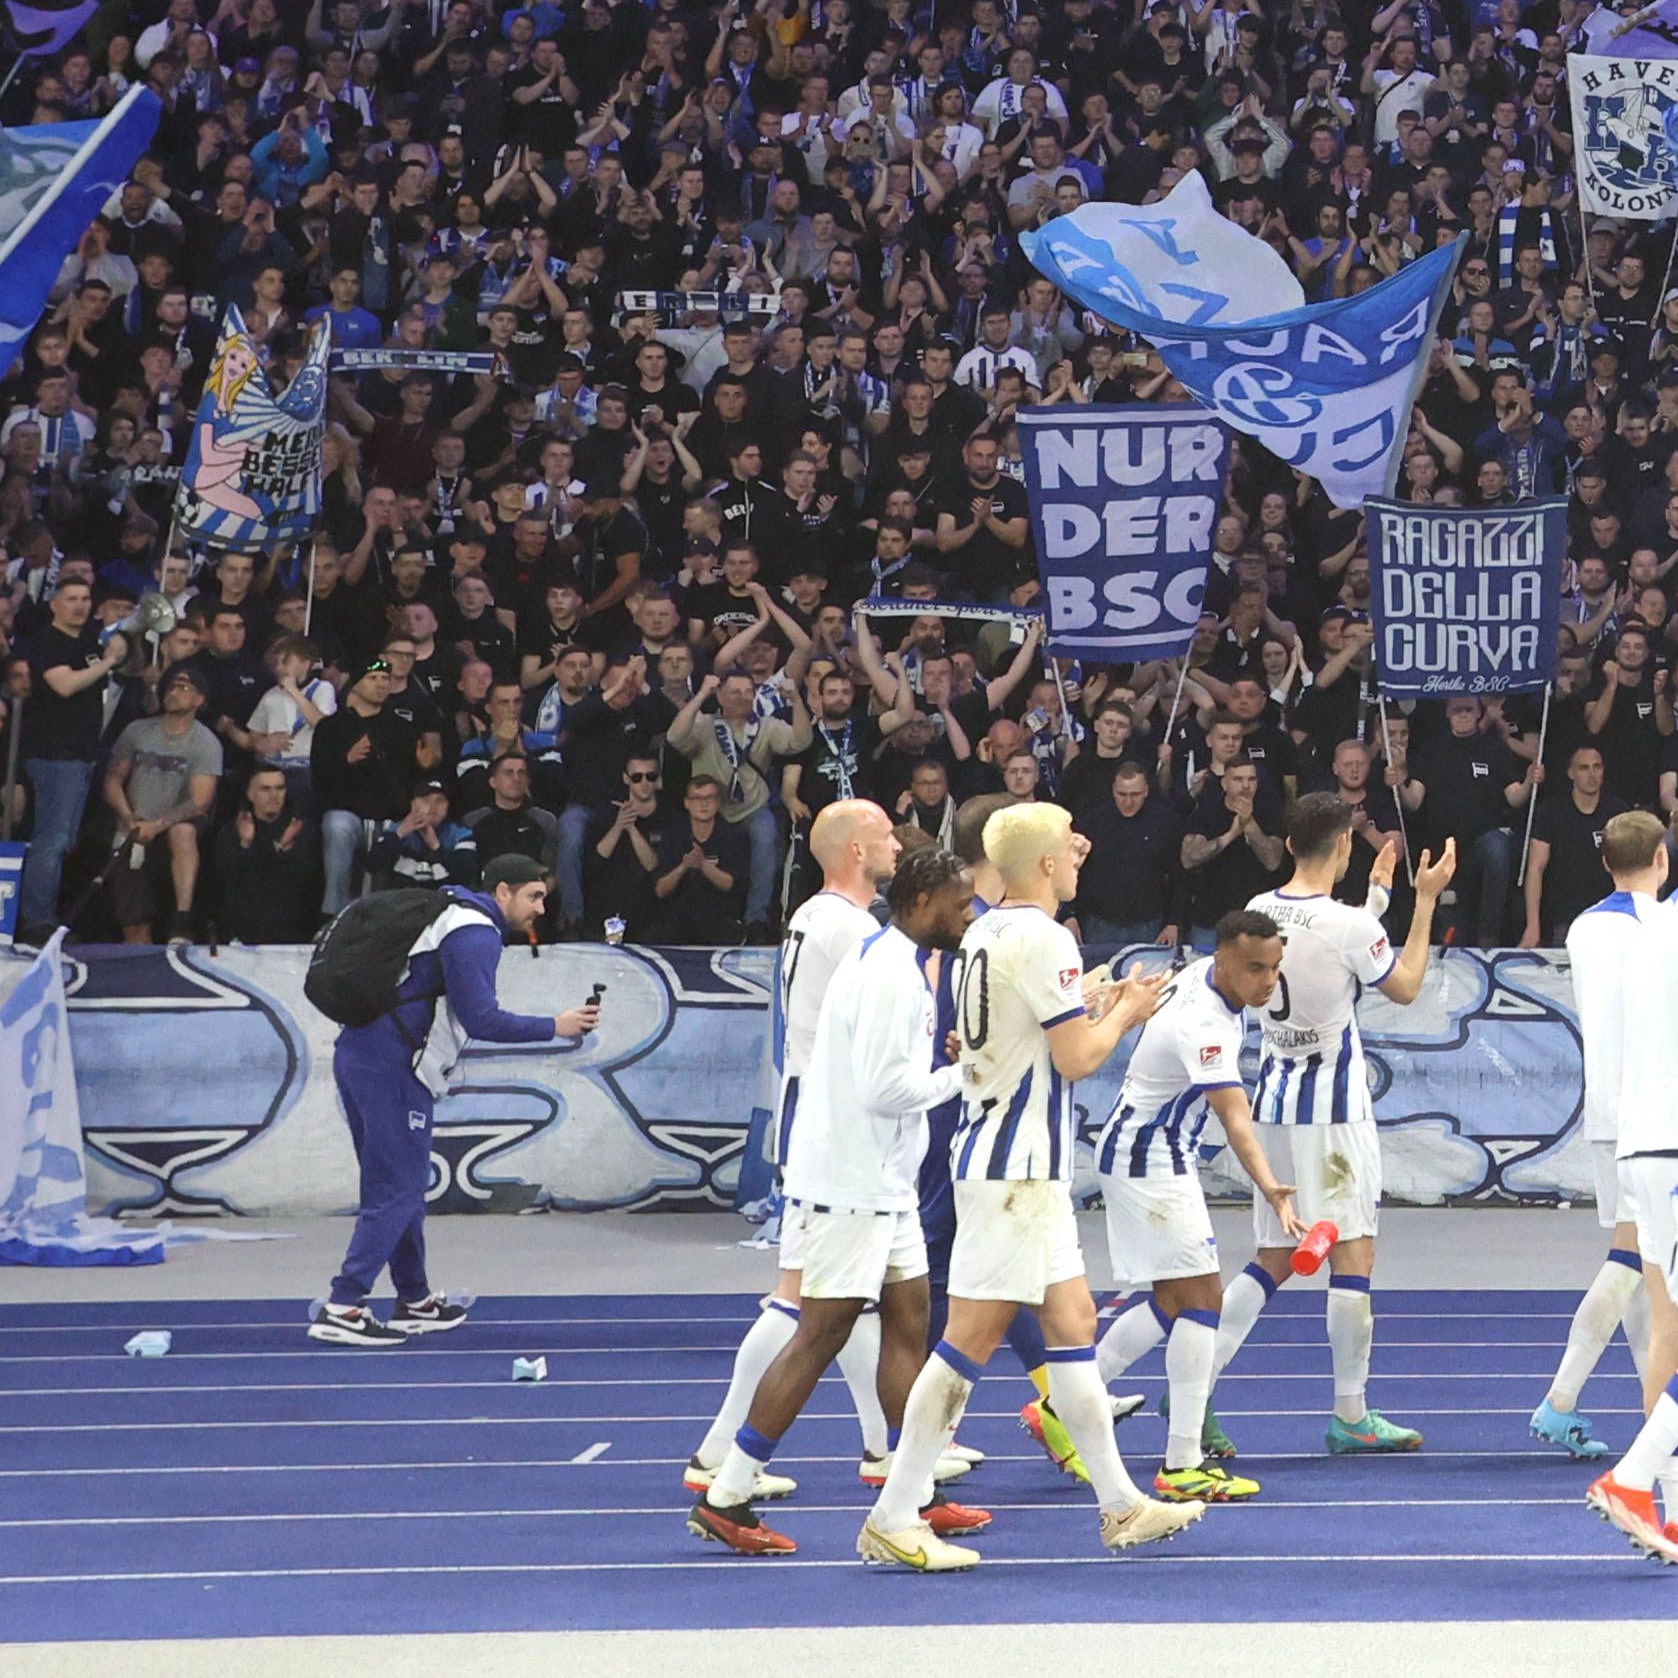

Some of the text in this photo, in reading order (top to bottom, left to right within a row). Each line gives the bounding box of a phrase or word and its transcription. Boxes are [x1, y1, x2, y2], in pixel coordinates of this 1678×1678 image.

[1585, 173, 1678, 212] KOLONN
[1034, 424, 1225, 490] NUR
[1040, 494, 1216, 559] DER
[1379, 512, 1545, 568] RAGAZZI
[1046, 566, 1208, 631] BSC
[1382, 568, 1542, 621] DELLA
[1384, 622, 1540, 672] CURVA
[1422, 674, 1511, 693] Hertha BSC
